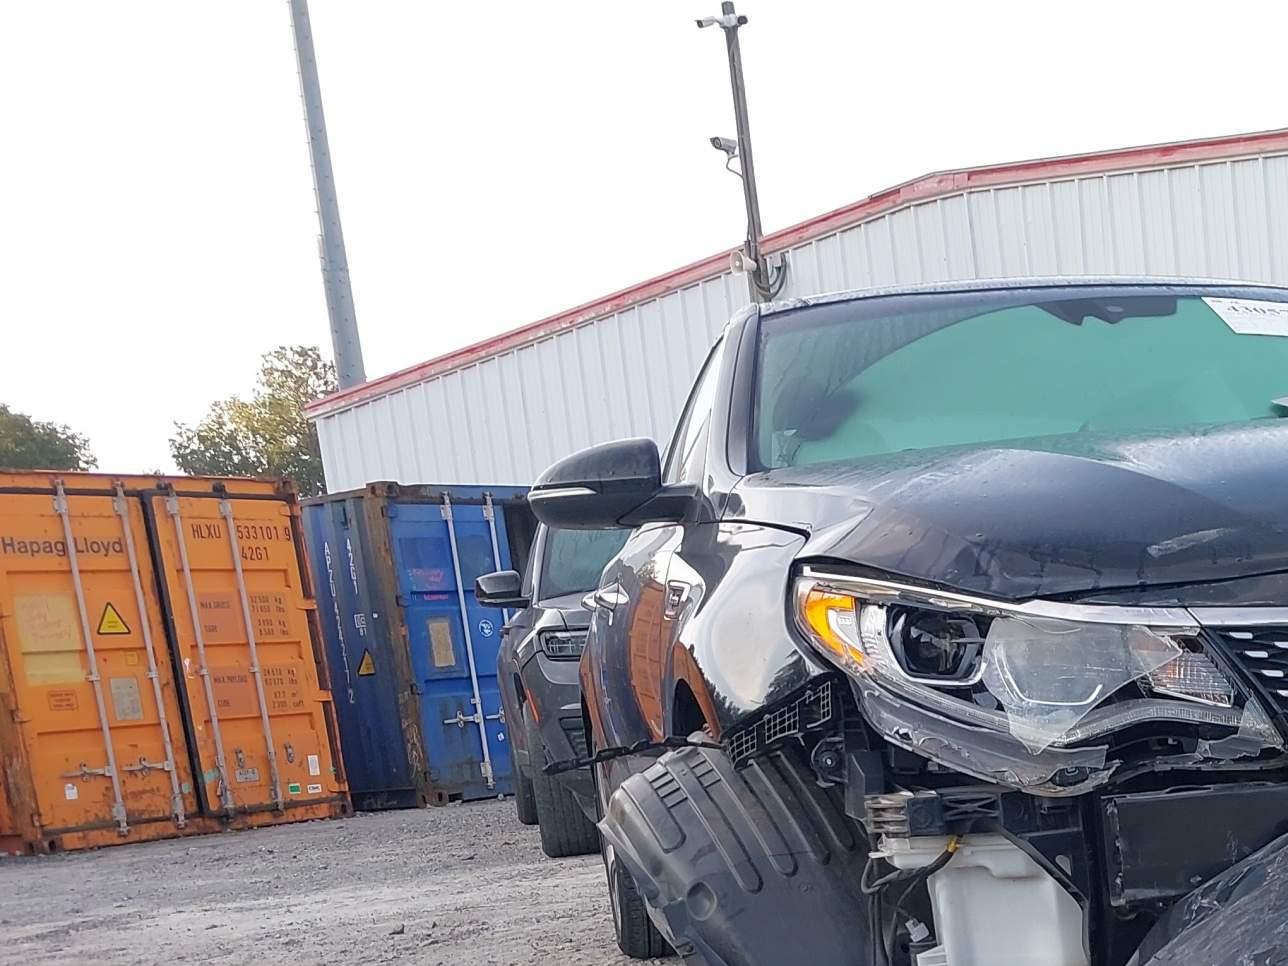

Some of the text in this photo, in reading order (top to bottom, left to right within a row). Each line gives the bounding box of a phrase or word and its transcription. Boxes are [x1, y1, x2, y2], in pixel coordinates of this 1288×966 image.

[191, 523, 291, 542] HLXU 533101 9
[1, 536, 123, 557] Hapag Lloyd
[241, 546, 269, 561] 42G1
